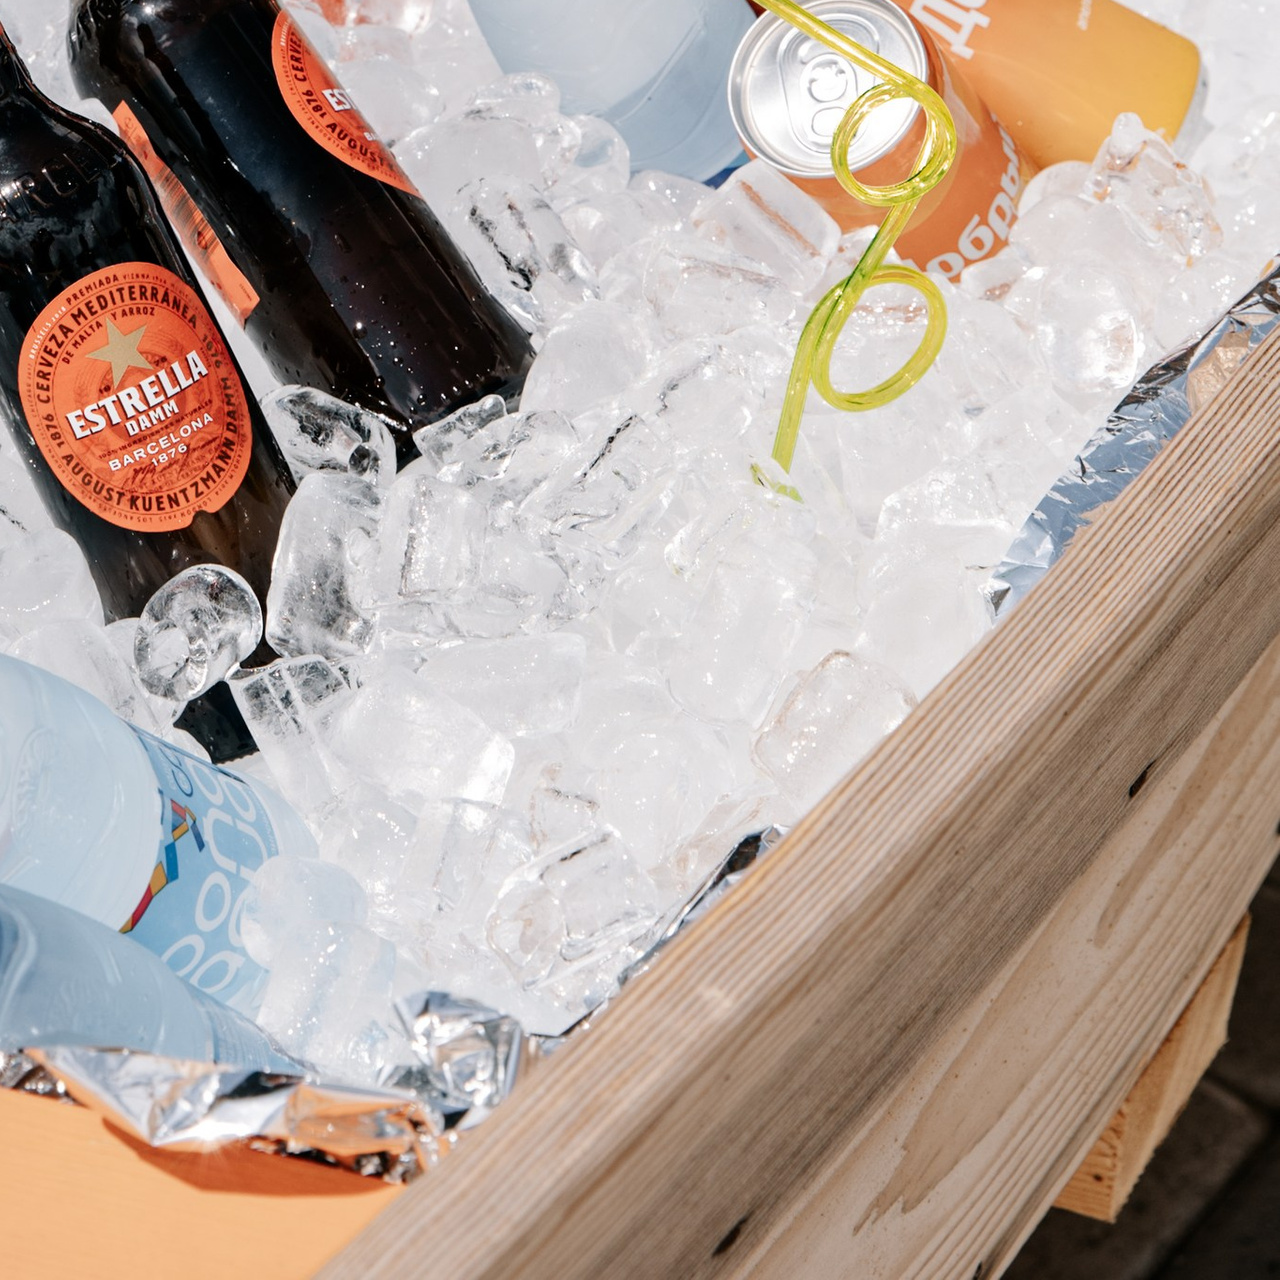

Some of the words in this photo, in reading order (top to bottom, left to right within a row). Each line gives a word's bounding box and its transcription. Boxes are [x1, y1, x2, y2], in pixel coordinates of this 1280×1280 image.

[302, 89, 327, 119] 1876
[325, 123, 384, 167] AUGUST
[66, 274, 119, 305] PREMIADA
[29, 322, 52, 360] BRUSSELS
[52, 306, 67, 322] 2018
[36, 323, 74, 404] CERVEZA
[70, 284, 198, 329] MEDITERRÁNEA
[62, 350, 74, 365] DE
[72, 320, 103, 349] MALTA
[110, 311, 118, 321] Y
[121, 306, 155, 318] ARROZ
[65, 349, 209, 439] ESTRELLA
[124, 399, 180, 437] DAMM
[42, 413, 65, 448] 1876
[108, 412, 214, 471] BARCELONA
[119, 421, 175, 451] INGREDIENTES
[176, 399, 213, 422] NATURALES
[62, 453, 125, 506] AUGUST
[129, 436, 236, 512] KUENTZMANN
[151, 443, 188, 467] 1876
[179, 494, 212, 519] LONDON
